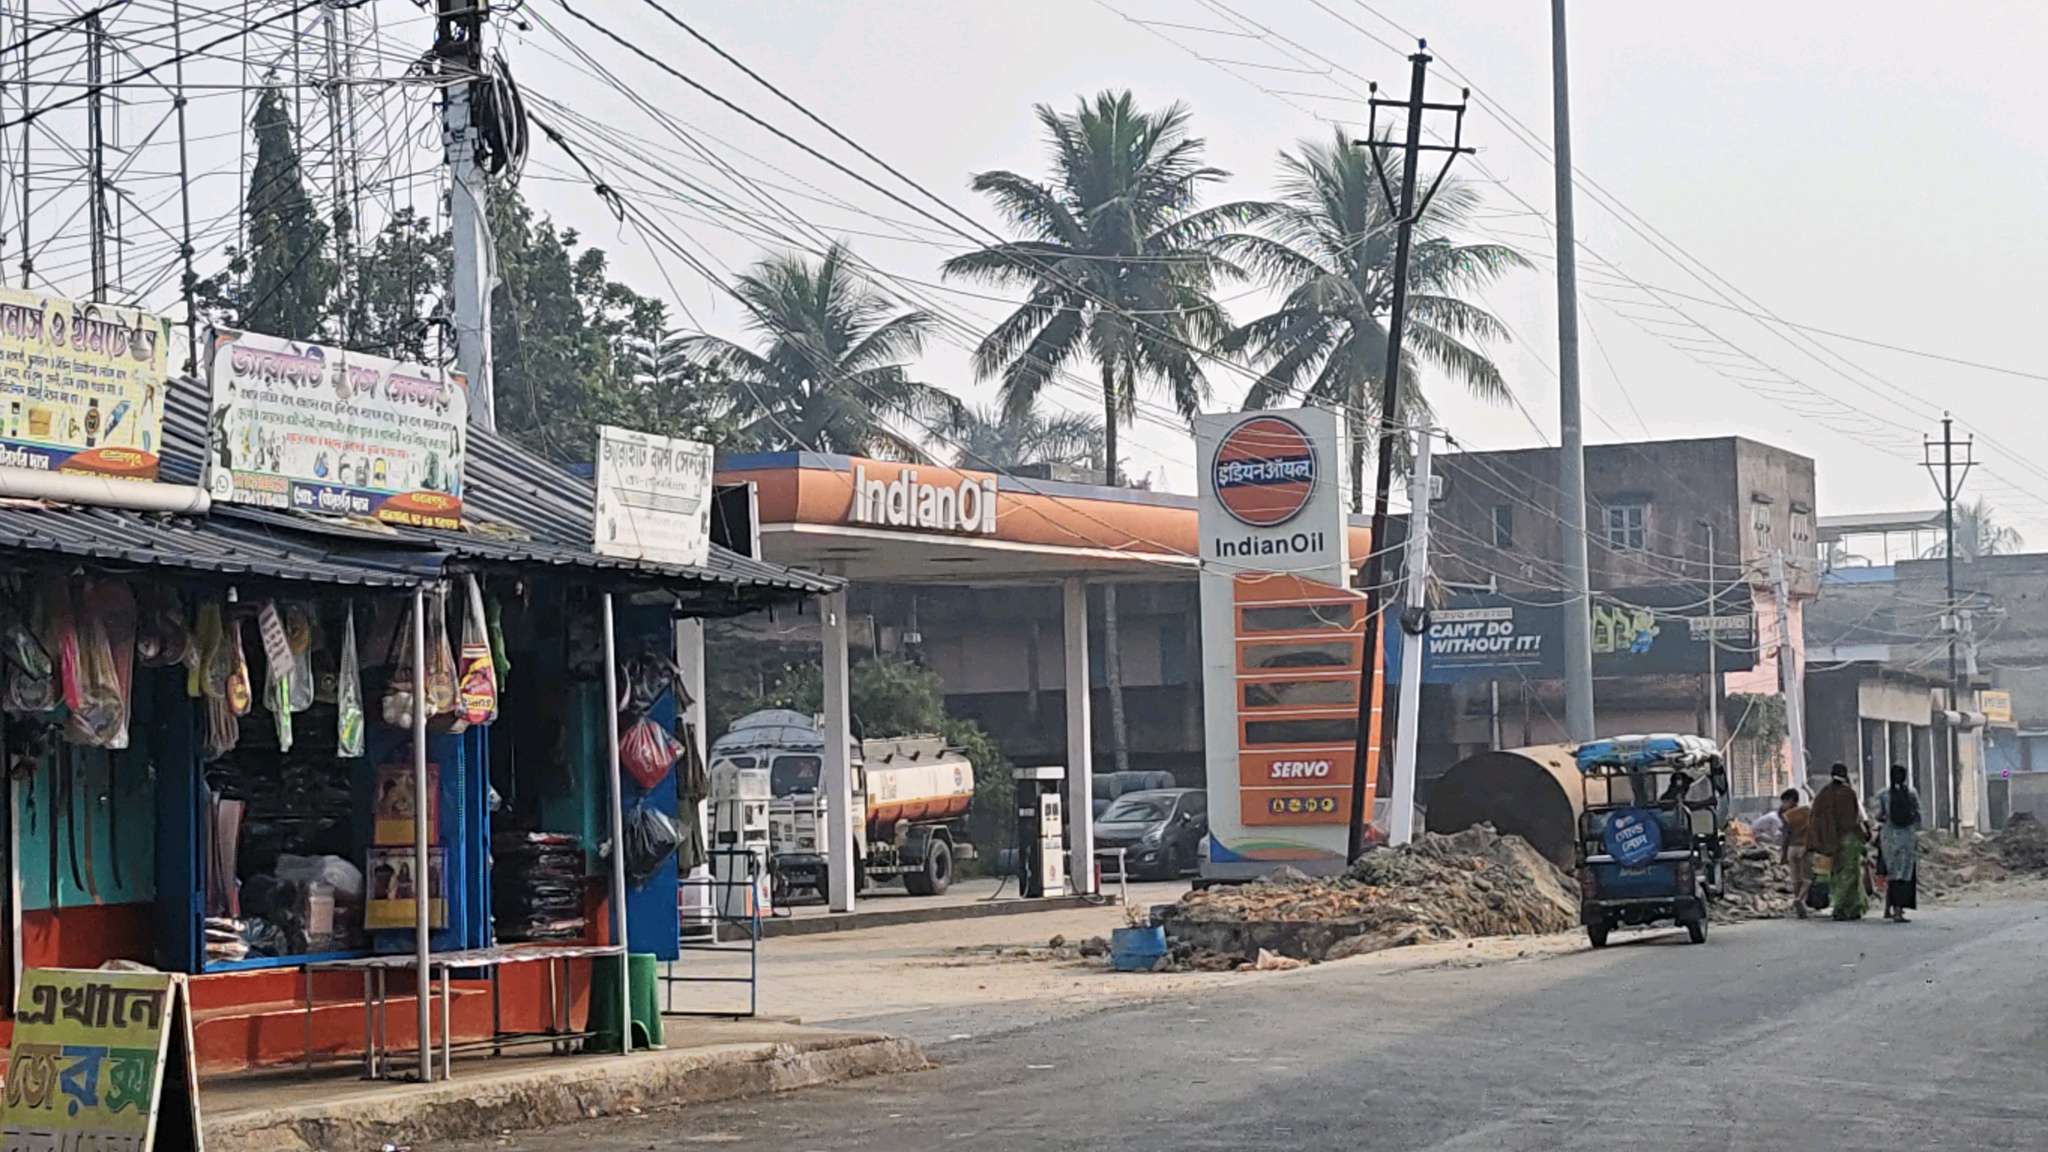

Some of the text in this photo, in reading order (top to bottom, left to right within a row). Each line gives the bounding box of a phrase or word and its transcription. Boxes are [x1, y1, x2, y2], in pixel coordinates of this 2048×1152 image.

[1218, 458, 1311, 487] इंडियनऑयल
[856, 465, 997, 534] IndianOil
[1216, 533, 1324, 557] IndianOil
[1429, 621, 1514, 638] CAN'T DO
[1430, 635, 1542, 653] WITHOUT IT!
[1271, 760, 1329, 778] SERVO
[17, 983, 167, 1030] এখানে
